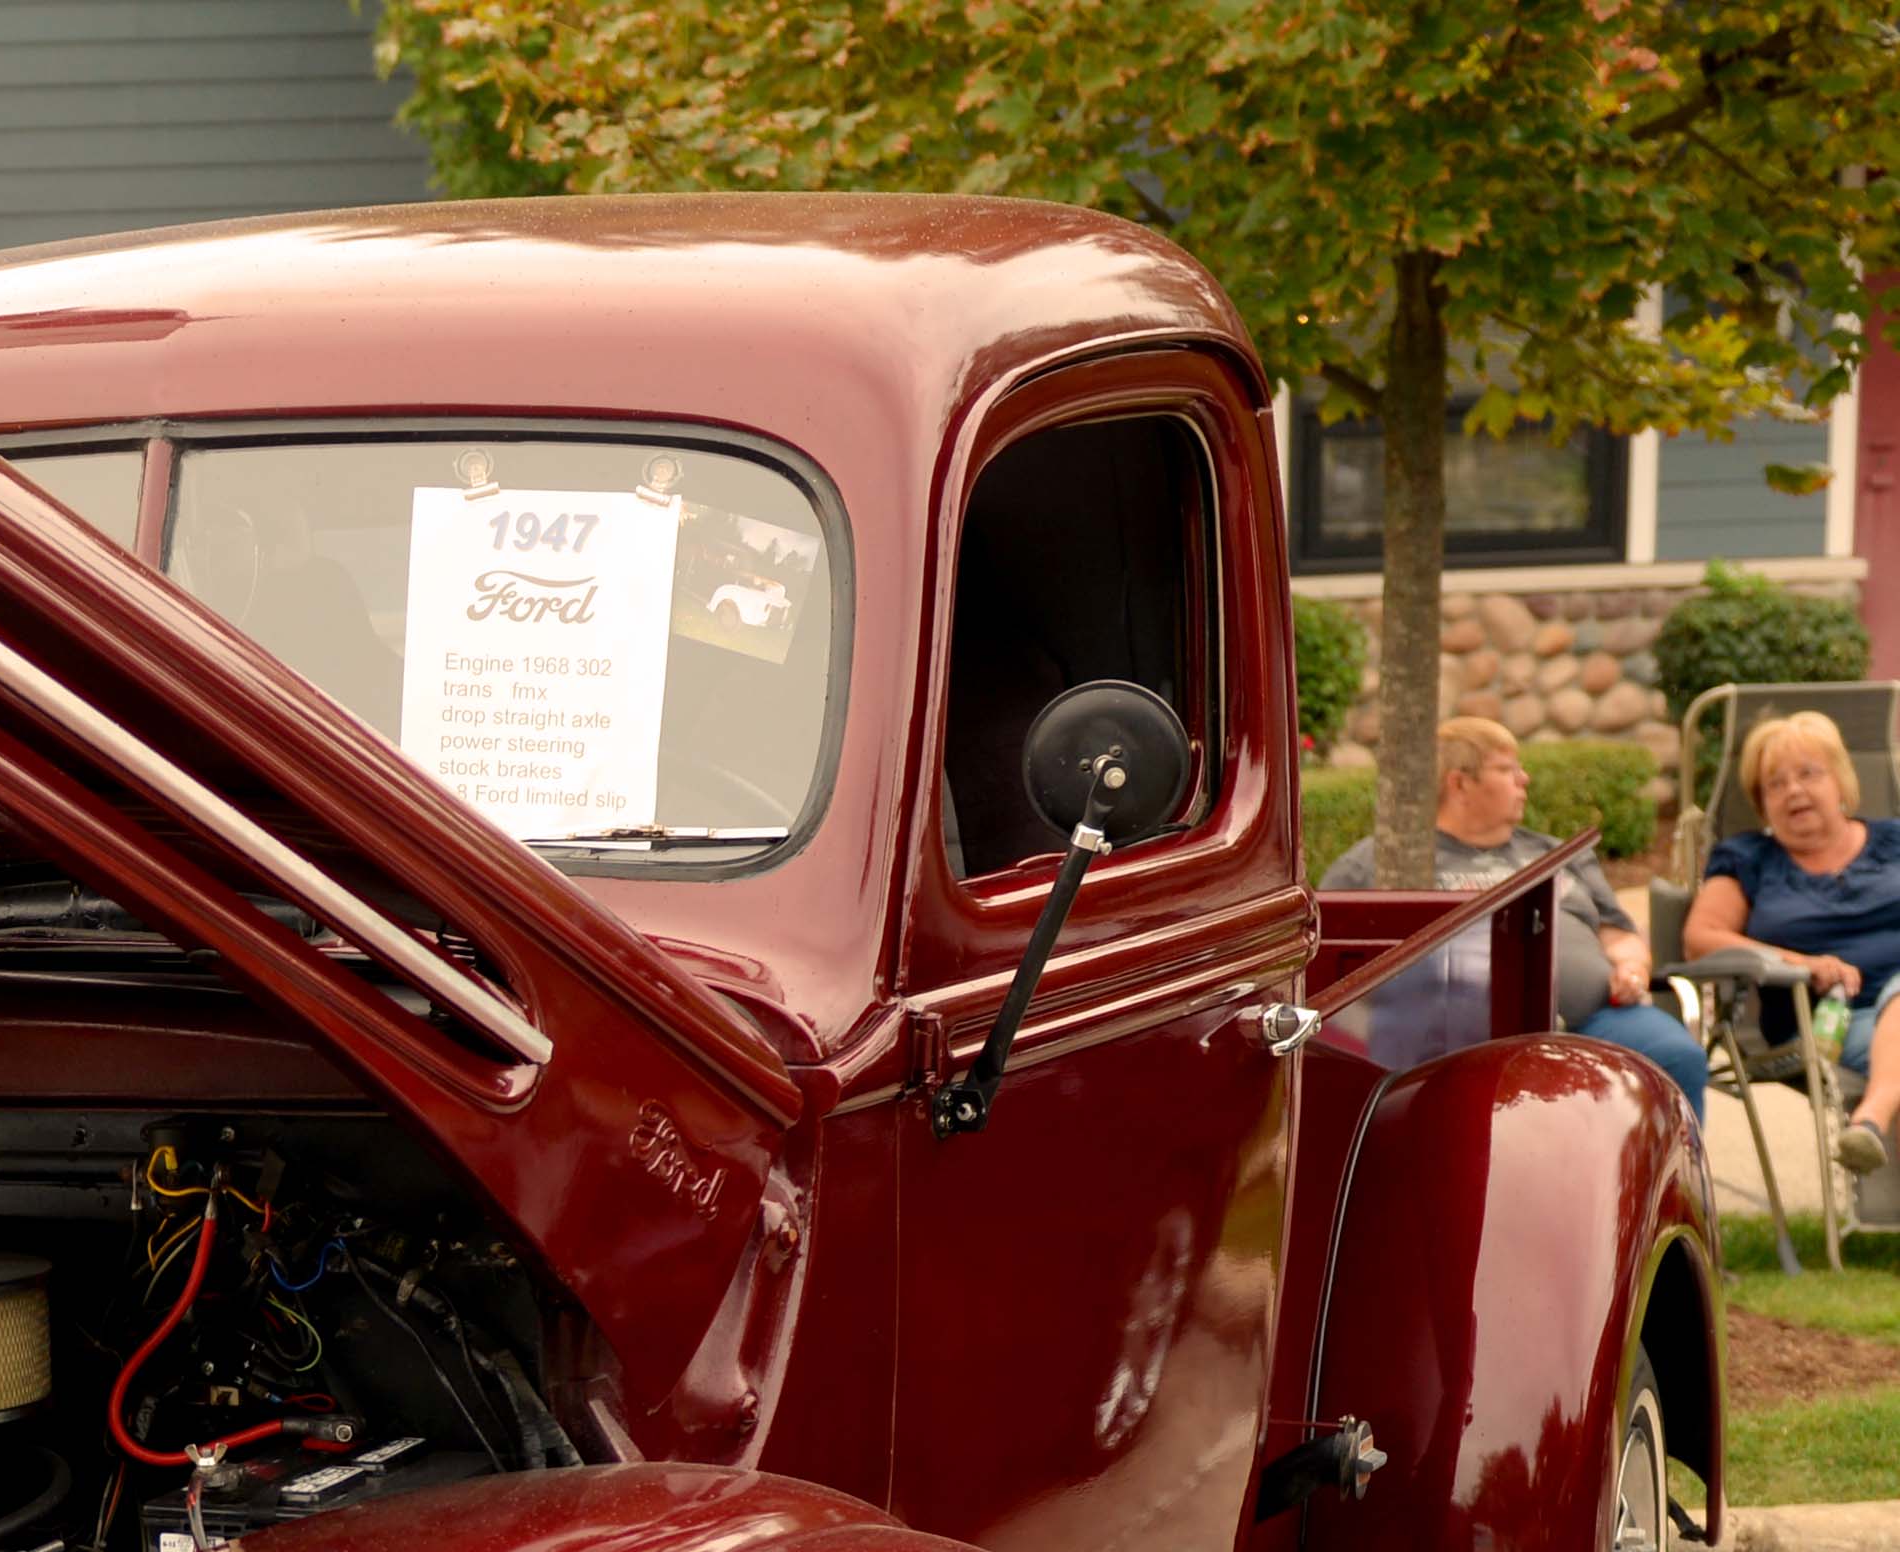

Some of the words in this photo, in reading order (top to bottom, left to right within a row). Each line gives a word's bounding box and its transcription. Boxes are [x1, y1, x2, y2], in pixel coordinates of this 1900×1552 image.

[489, 510, 600, 553] 1947
[466, 569, 599, 625] Ford
[445, 652, 514, 677] Engine
[523, 656, 570, 675] 1968
[576, 658, 612, 677] 302
[443, 680, 492, 698] trans
[512, 682, 548, 701] fmx
[442, 706, 486, 728] drop
[493, 708, 565, 731] straight
[571, 712, 612, 729] axle
[440, 735, 501, 753] power
[508, 737, 585, 759] steering
[438, 759, 490, 777] stock
[497, 760, 563, 780] brakes
[475, 784, 519, 805] Ford
[526, 787, 588, 808] limited
[594, 791, 627, 813] slip
